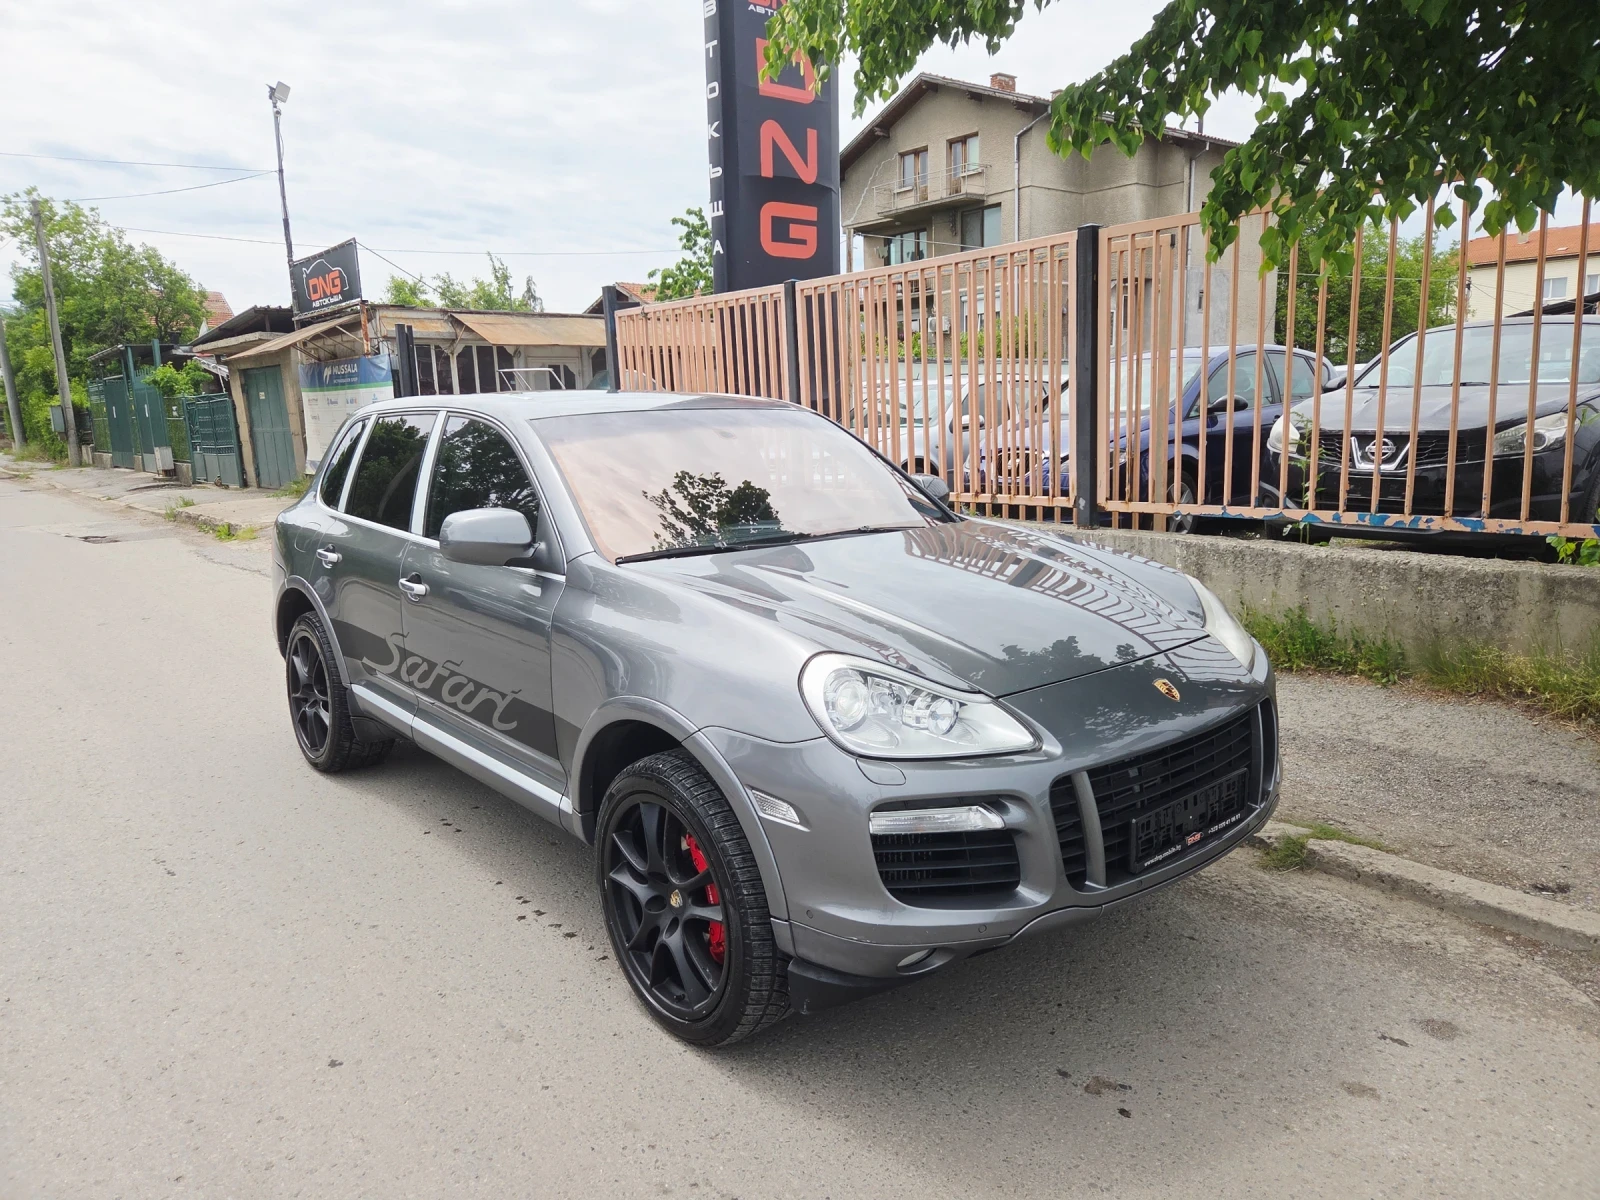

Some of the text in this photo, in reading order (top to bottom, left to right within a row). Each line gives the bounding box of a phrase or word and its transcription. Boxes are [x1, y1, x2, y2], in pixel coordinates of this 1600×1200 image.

[755, 37, 818, 259] DNG
[309, 269, 341, 301] DNG
[332, 363, 359, 375] MUSSALA
[361, 631, 522, 731] Safari
